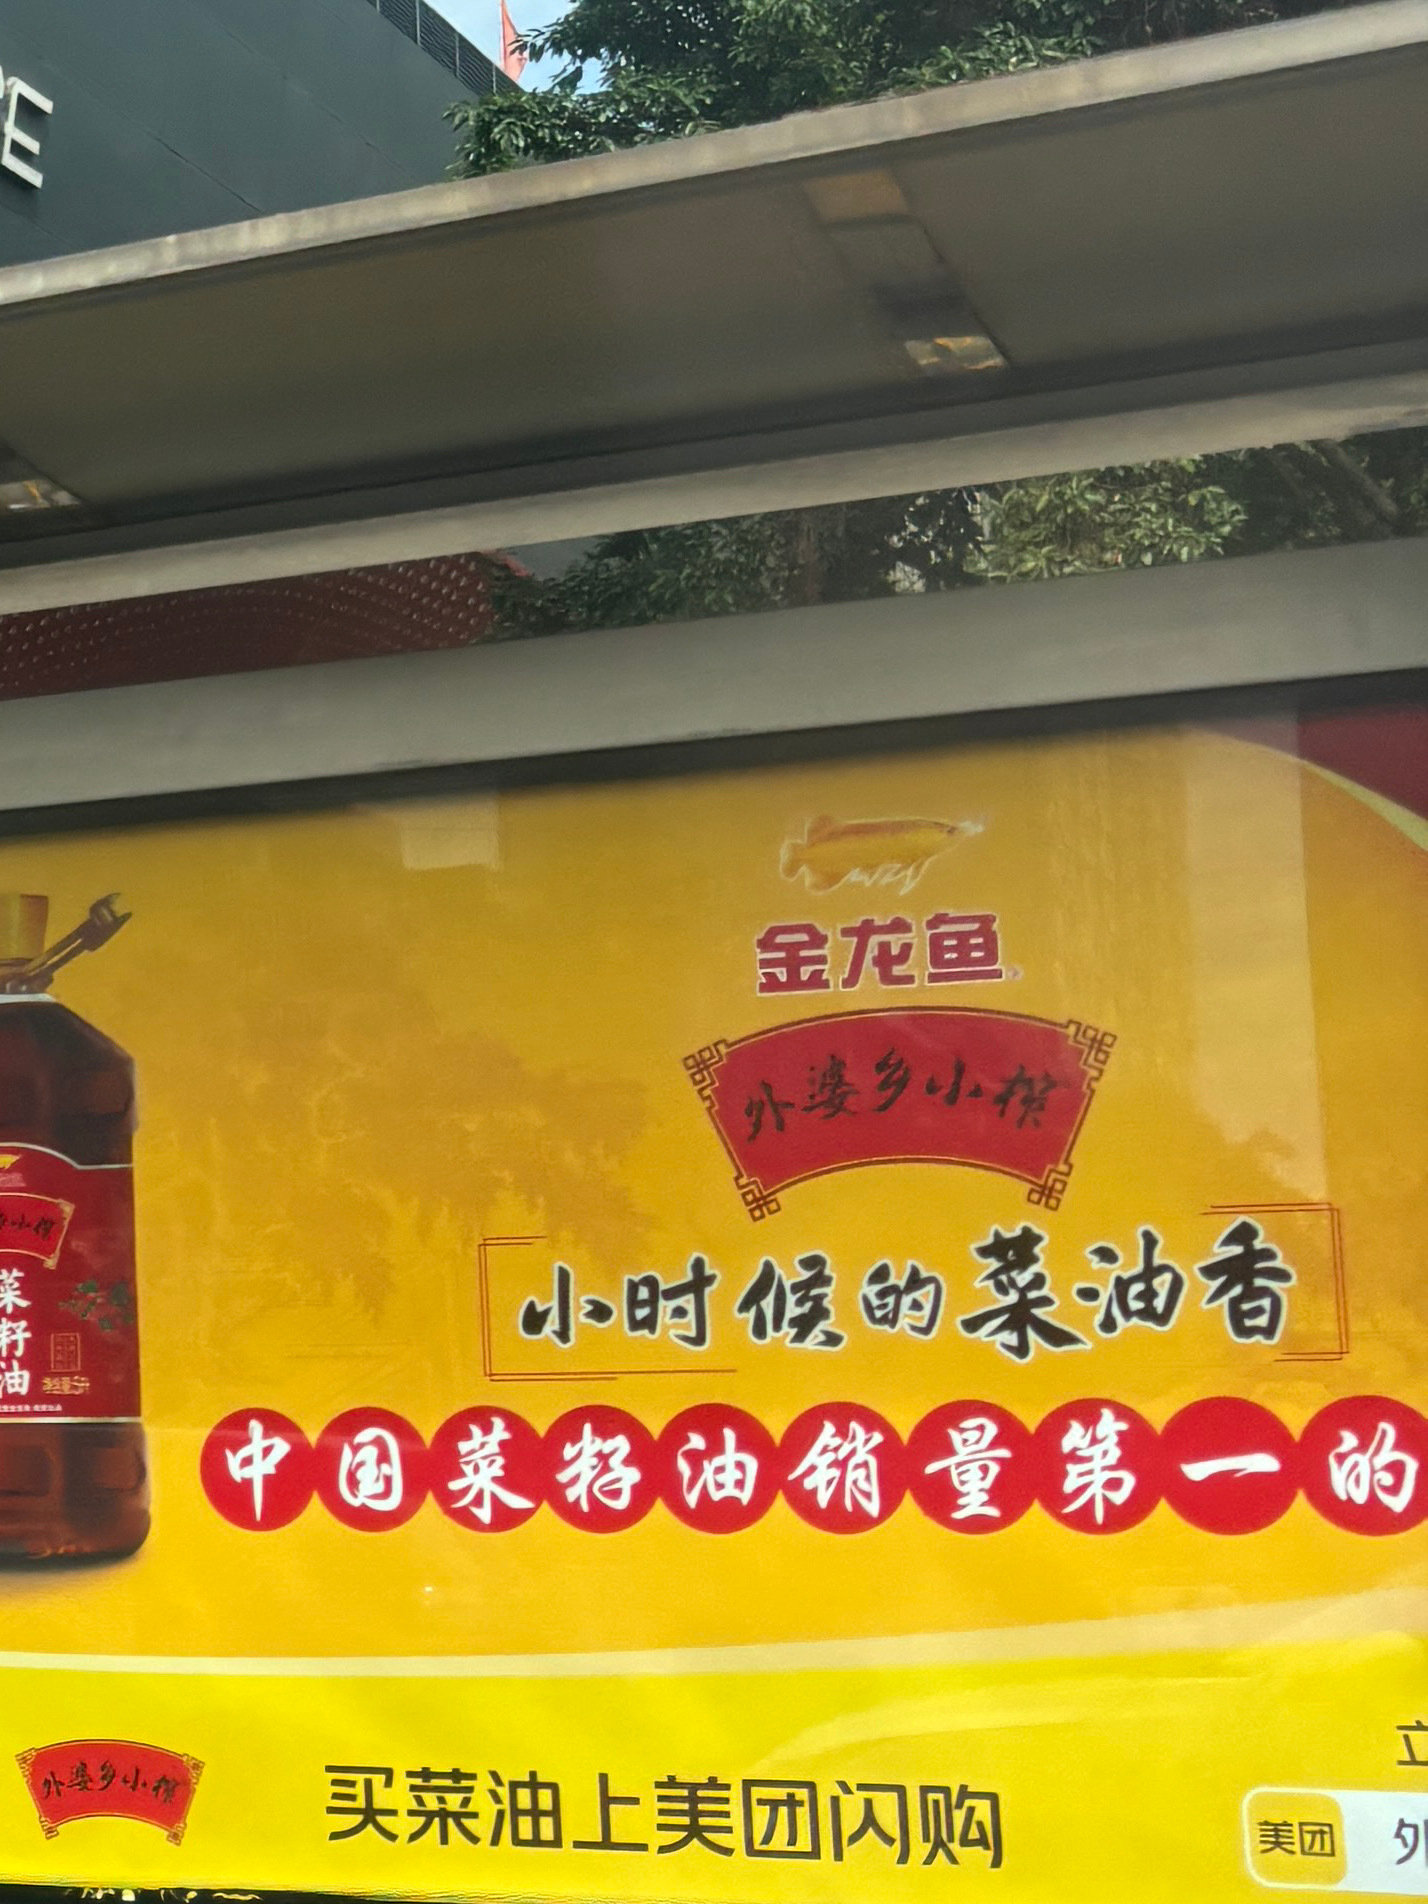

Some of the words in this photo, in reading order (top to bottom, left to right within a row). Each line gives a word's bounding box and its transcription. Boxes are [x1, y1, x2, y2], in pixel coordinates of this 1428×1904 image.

[755, 912, 1004, 994] 金龙鱼
[520, 1220, 1296, 1360] 小时候的菜油香
[224, 1414, 1420, 1524] 中国菜籽油销量第一的
[325, 1764, 1003, 1869] 买菜油上美团闪购
[1257, 1820, 1336, 1857] 美团
